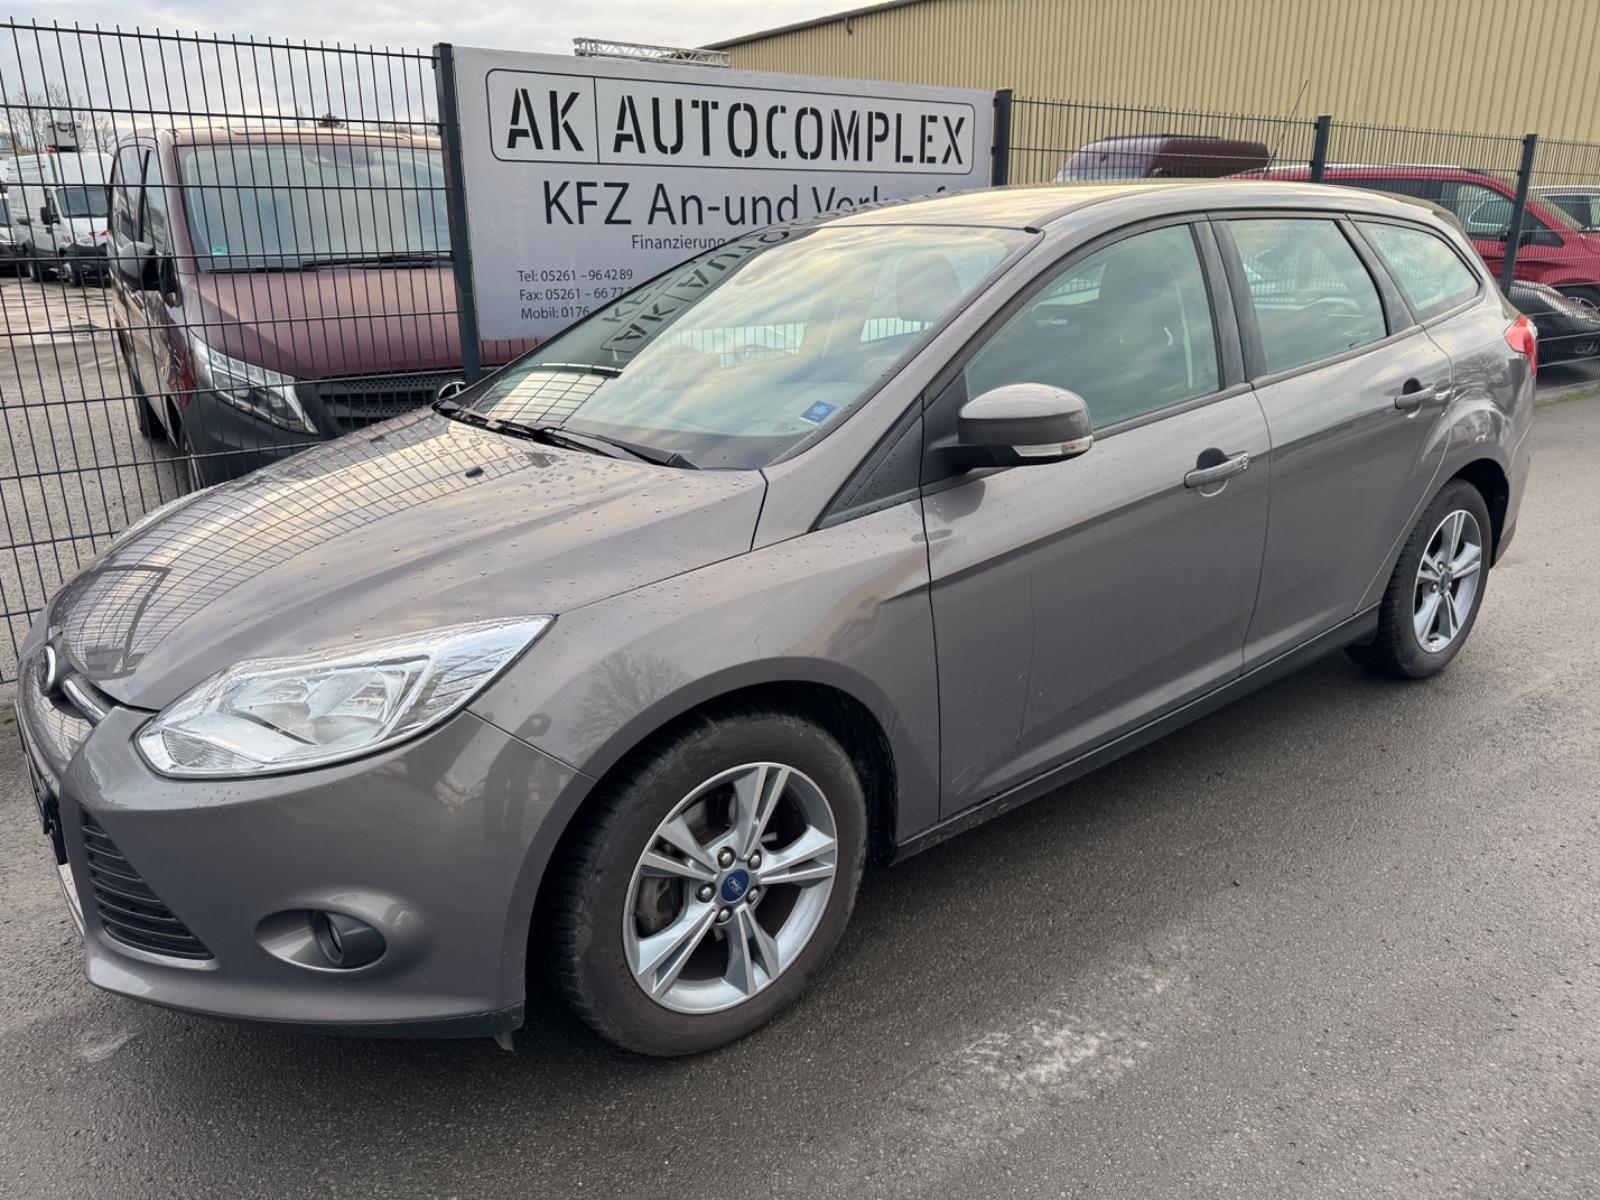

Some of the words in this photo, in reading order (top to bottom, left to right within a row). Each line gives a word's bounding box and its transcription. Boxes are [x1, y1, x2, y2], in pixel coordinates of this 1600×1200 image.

[507, 88, 584, 151] AK
[613, 95, 966, 165] AUTOCOMPLEX
[543, 180, 632, 225] KFZ
[517, 270, 538, 282] Tel:
[541, 270, 576, 281] 05261
[519, 288, 543, 301] Fax:
[545, 288, 580, 301] 05261
[521, 306, 559, 319] Mobil:
